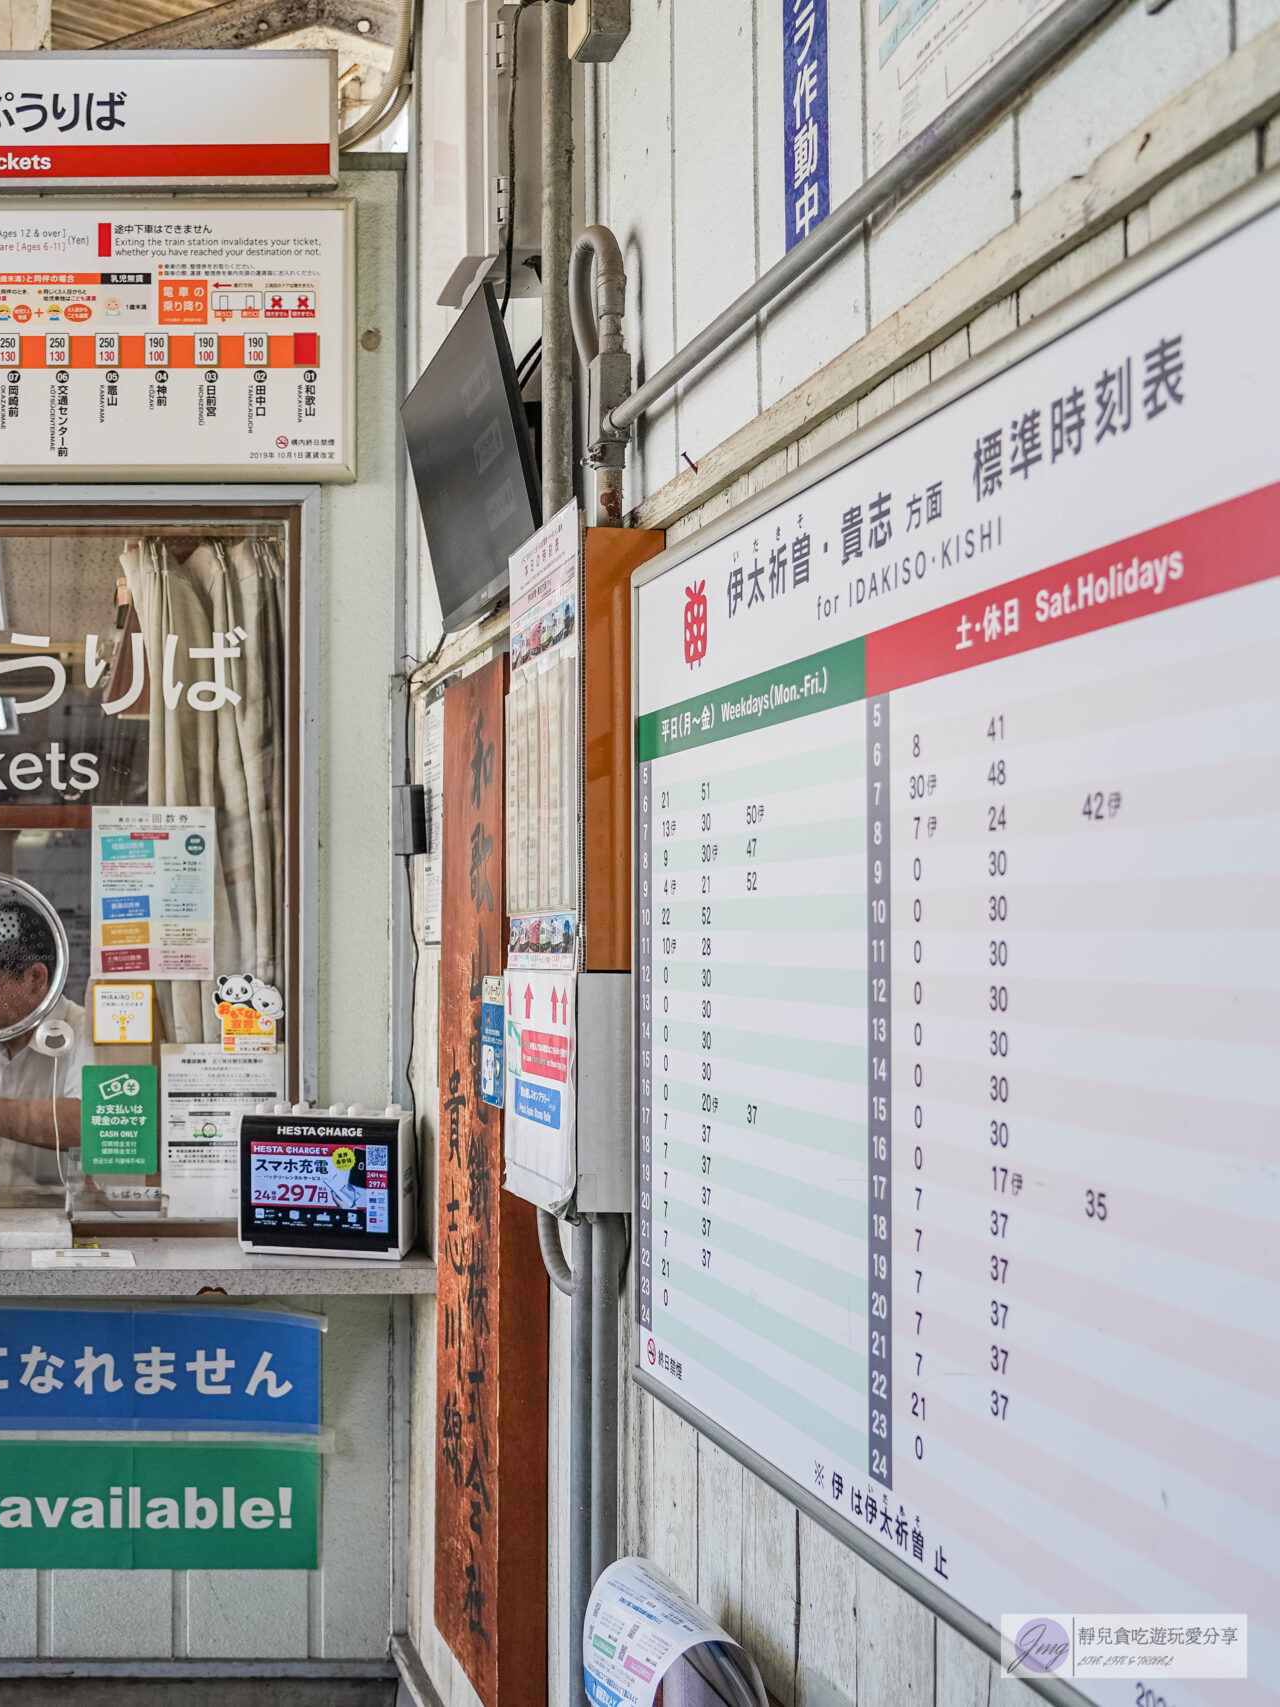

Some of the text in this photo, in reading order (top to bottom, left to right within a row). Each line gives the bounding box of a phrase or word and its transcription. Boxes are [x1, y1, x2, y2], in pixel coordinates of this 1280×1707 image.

[20, 229, 31, 238] 12
[33, 229, 40, 238] &
[114, 224, 213, 234] 途中下車はできません
[68, 235, 89, 246] (Yen)
[115, 237, 322, 248] Exiting the train station invalidates your ticket,
[115, 248, 149, 256] whether
[151, 249, 166, 258] you
[168, 248, 188, 256] have
[190, 248, 223, 256] reached
[225, 249, 244, 258] your
[245, 248, 291, 256] destination
[305, 248, 322, 256] not.
[110, 274, 144, 284] 乳児無賃
[163, 286, 205, 298] 電車の
[162, 301, 204, 312] 乗り降り
[149, 338, 165, 348] 190
[305, 372, 316, 381] 01
[156, 385, 167, 406] 神前
[206, 385, 217, 417] 日前宮
[255, 385, 266, 417] 田中口
[305, 385, 316, 417] 和歌山
[57, 385, 68, 457] 交通センター前
[905, 481, 943, 534] 方面
[972, 334, 1186, 502] 標準時刻表
[816, 593, 840, 621] for
[955, 549, 1185, 651] 土・休日 Sat.Holidays
[912, 714, 1005, 758] 8 41
[987, 759, 1006, 787] 48
[642, 782, 710, 813] 6 21 51
[987, 805, 1006, 832] 24
[988, 850, 1007, 877] 30
[641, 906, 711, 926] 10 22 52
[131, 991, 145, 1000] ID
[95, 1104, 143, 1115] お支払いは
[746, 1103, 758, 1125] 37
[91, 1115, 148, 1126] 現金のみです
[99, 1130, 139, 1138] CASH ONLY
[253, 1145, 284, 1154] HESTA
[255, 1159, 329, 1175] スマホ充電
[1085, 1188, 1108, 1221] 35
[871, 1370, 926, 1421] 22 21
[934, 1545, 948, 1580] 止
